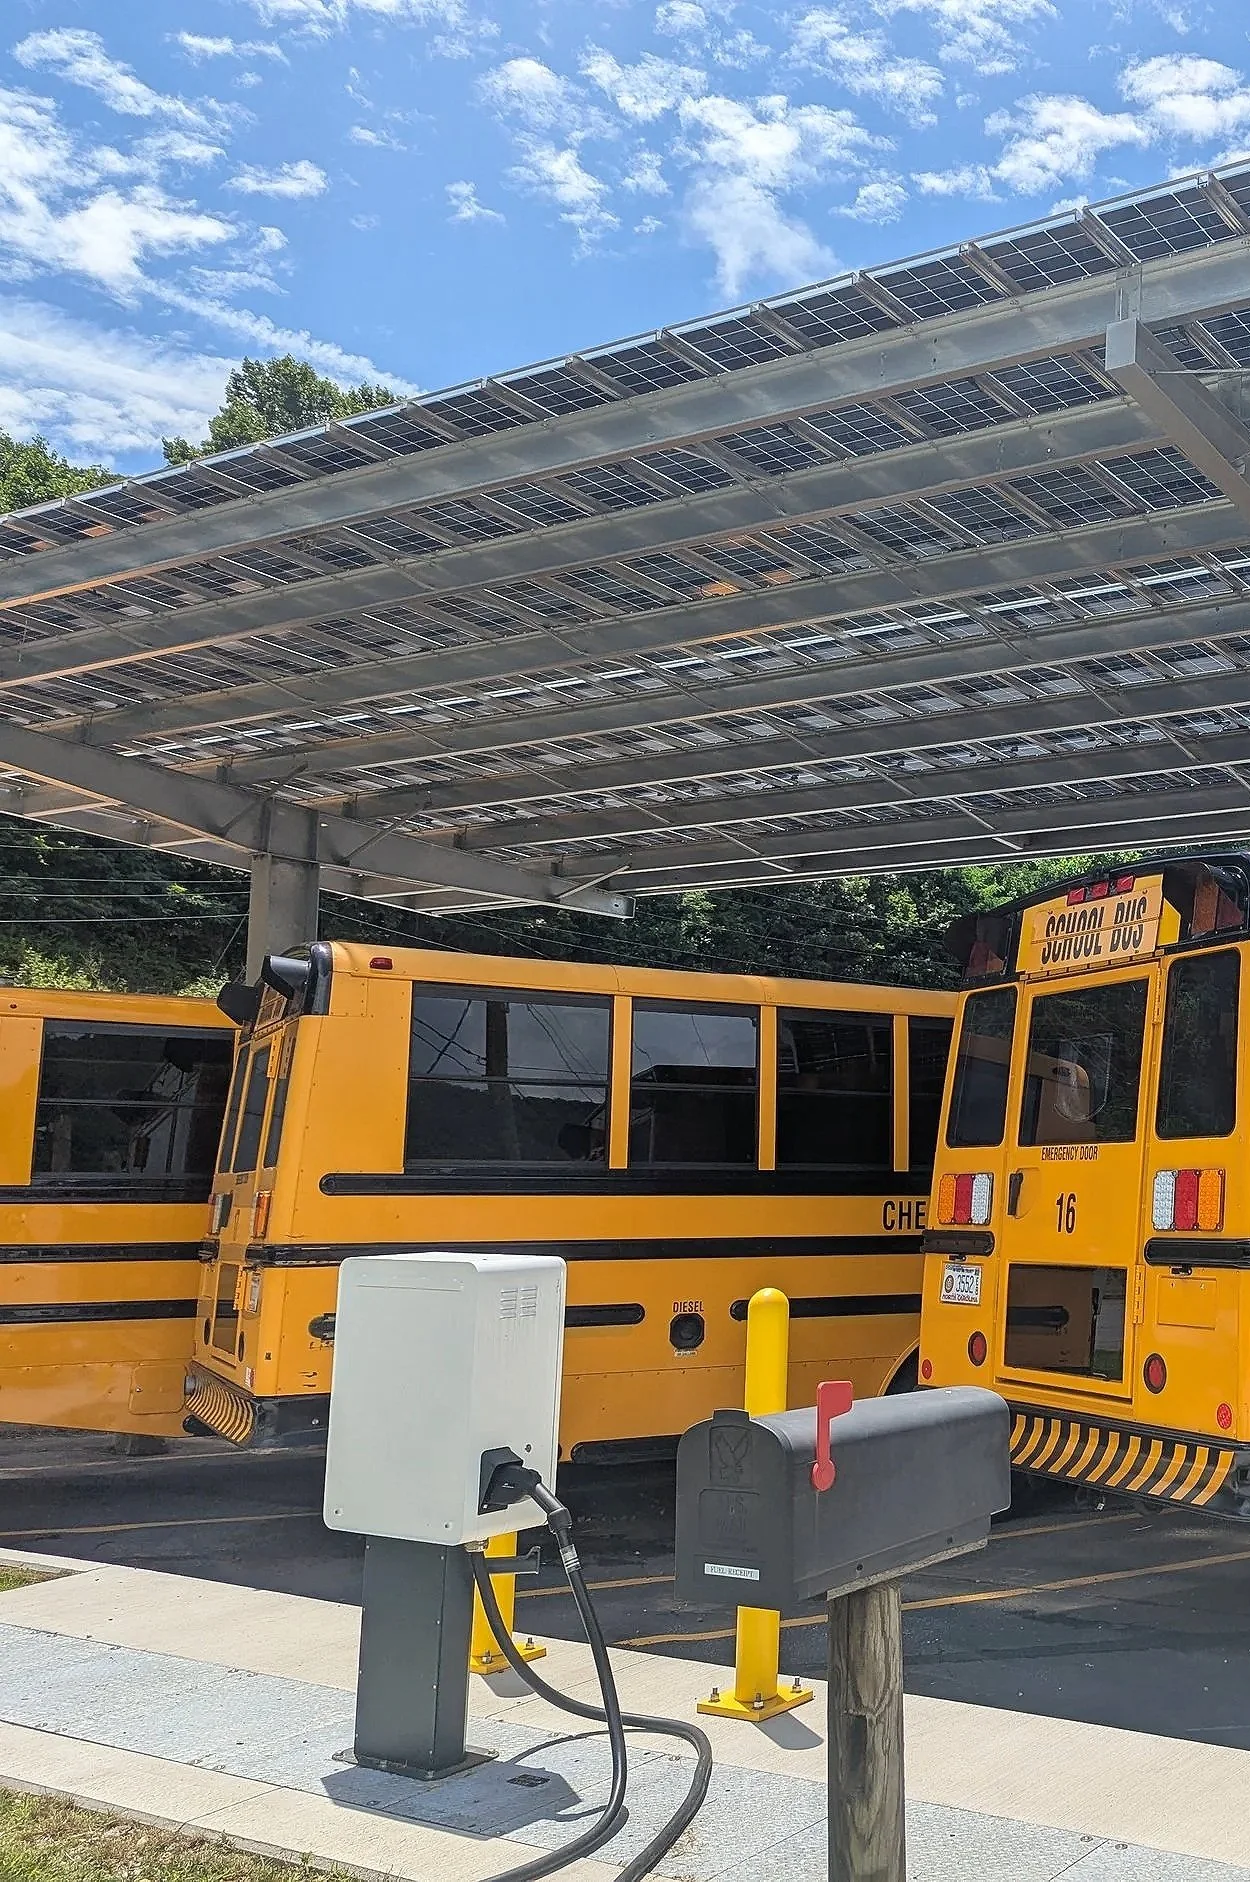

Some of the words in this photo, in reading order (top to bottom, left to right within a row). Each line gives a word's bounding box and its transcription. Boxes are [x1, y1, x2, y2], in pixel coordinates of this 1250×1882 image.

[1041, 906, 1105, 965] SCHOOL
[1109, 896, 1147, 953] BUS
[1041, 1146, 1079, 1161] EMERGENCY
[1079, 1145, 1099, 1160] DOOR
[1056, 1193, 1077, 1234] 16
[673, 1300, 705, 1313] DIESEL
